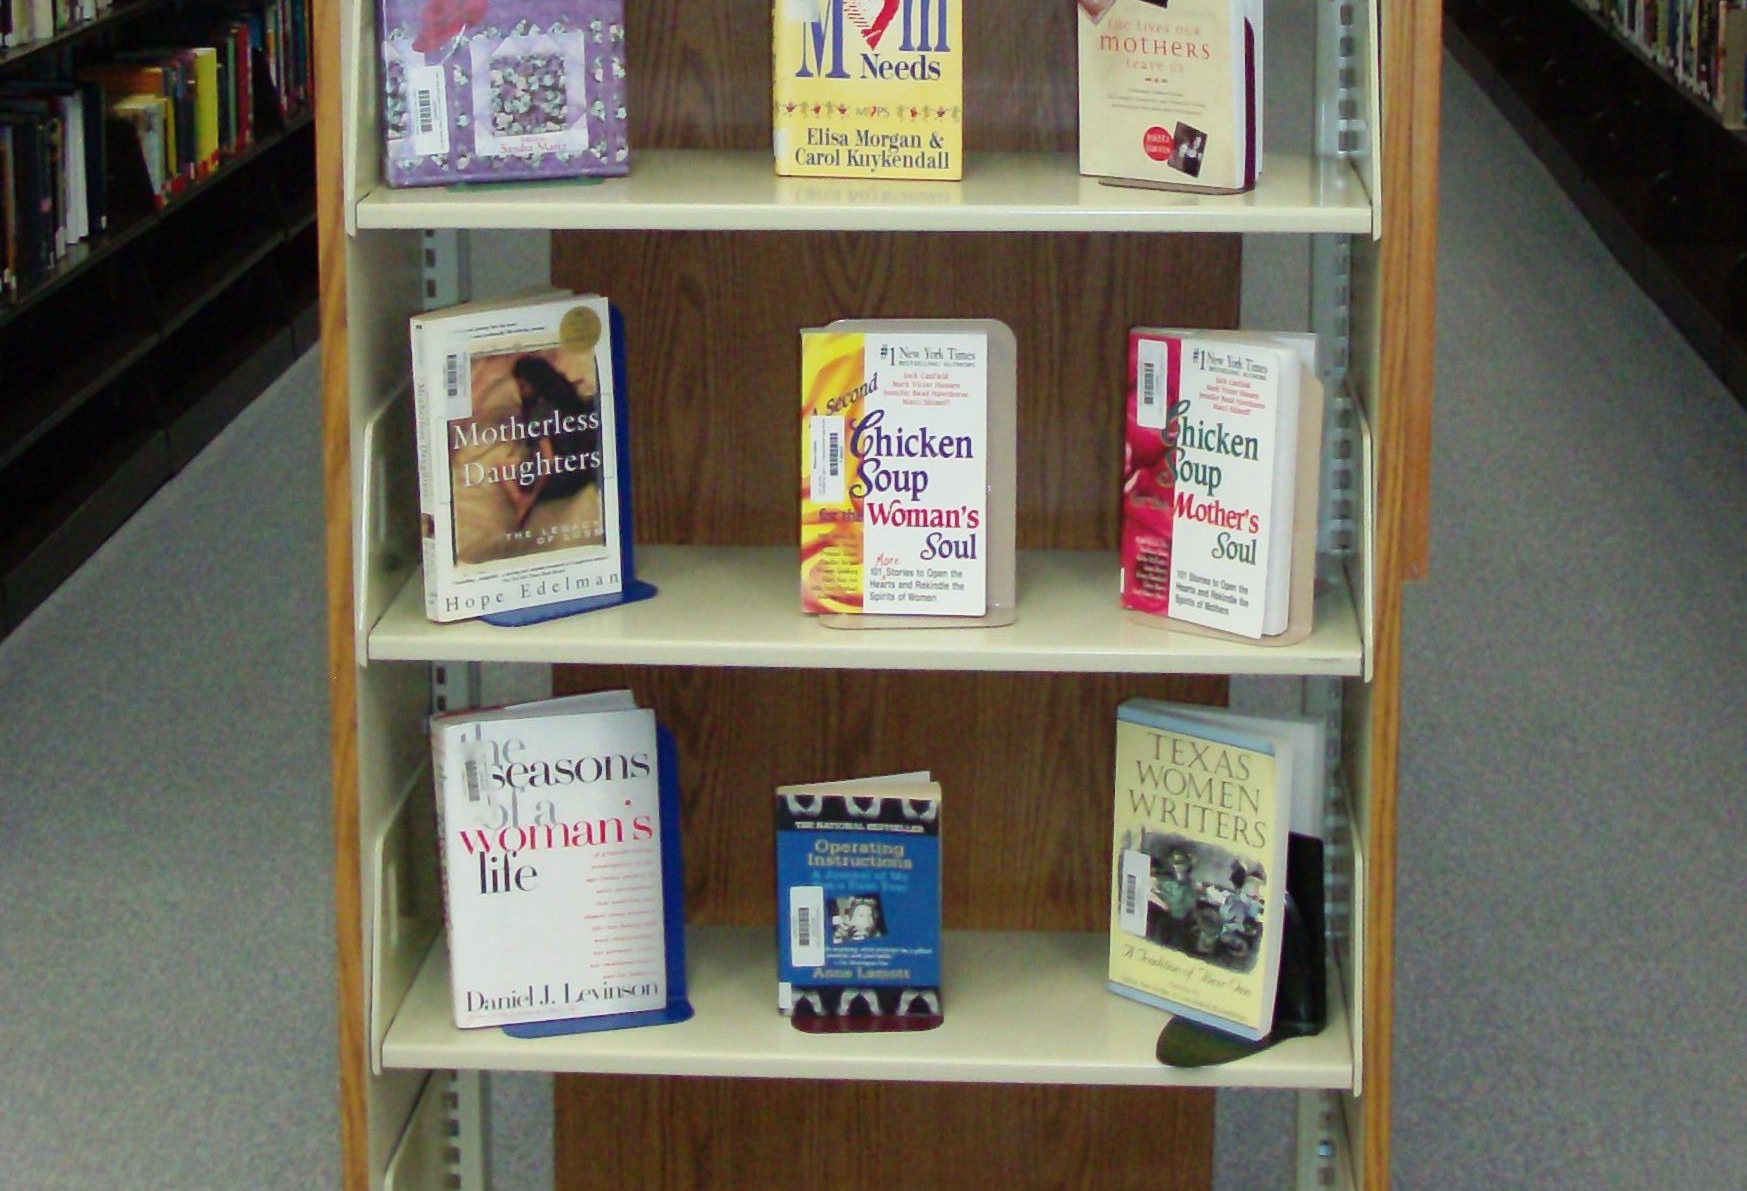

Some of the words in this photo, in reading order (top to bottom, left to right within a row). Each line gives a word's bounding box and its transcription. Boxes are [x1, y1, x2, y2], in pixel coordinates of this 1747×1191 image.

[860, 54, 942, 81] Needs
[808, 127, 849, 146] Elisa
[855, 129, 922, 153] Morgan
[929, 131, 945, 149] &
[795, 147, 840, 166] Carol
[847, 149, 950, 172] Kuykendall
[880, 344, 895, 366] #1
[899, 347, 920, 359] New
[923, 347, 944, 360] York
[947, 347, 976, 360] Times
[1192, 348, 1206, 370] #1
[453, 410, 600, 450] Motherless
[850, 409, 974, 459] Chicken
[1161, 399, 1259, 461] Chicken
[464, 450, 602, 487] Daughters
[849, 457, 929, 501] Soup
[1157, 446, 1222, 496] Soup
[867, 500, 980, 529] Woman's
[1174, 491, 1259, 534] Mother's
[920, 532, 978, 560] Soul
[1212, 531, 1256, 565] Soul
[870, 580, 895, 589] Hearts
[898, 580, 913, 589] and
[952, 581, 965, 590] the
[886, 568, 913, 577] Stories
[916, 568, 925, 576] to
[927, 568, 948, 579] Open
[951, 568, 963, 578] the
[445, 592, 505, 612] Hope
[520, 573, 620, 599] Edelman
[870, 592, 895, 602] Spirits
[898, 591, 908, 601] of
[908, 593, 937, 602] Women
[491, 752, 650, 790] seasons
[1148, 731, 1251, 781] TEXAS
[1136, 760, 1260, 814] WOMEN
[534, 799, 557, 826] a
[1128, 789, 1267, 849] WRITERS
[815, 839, 905, 858] Operating
[479, 849, 538, 895] life
[467, 985, 534, 1012] Daniel
[539, 984, 555, 1005] J.
[564, 980, 659, 1004] Levinson
